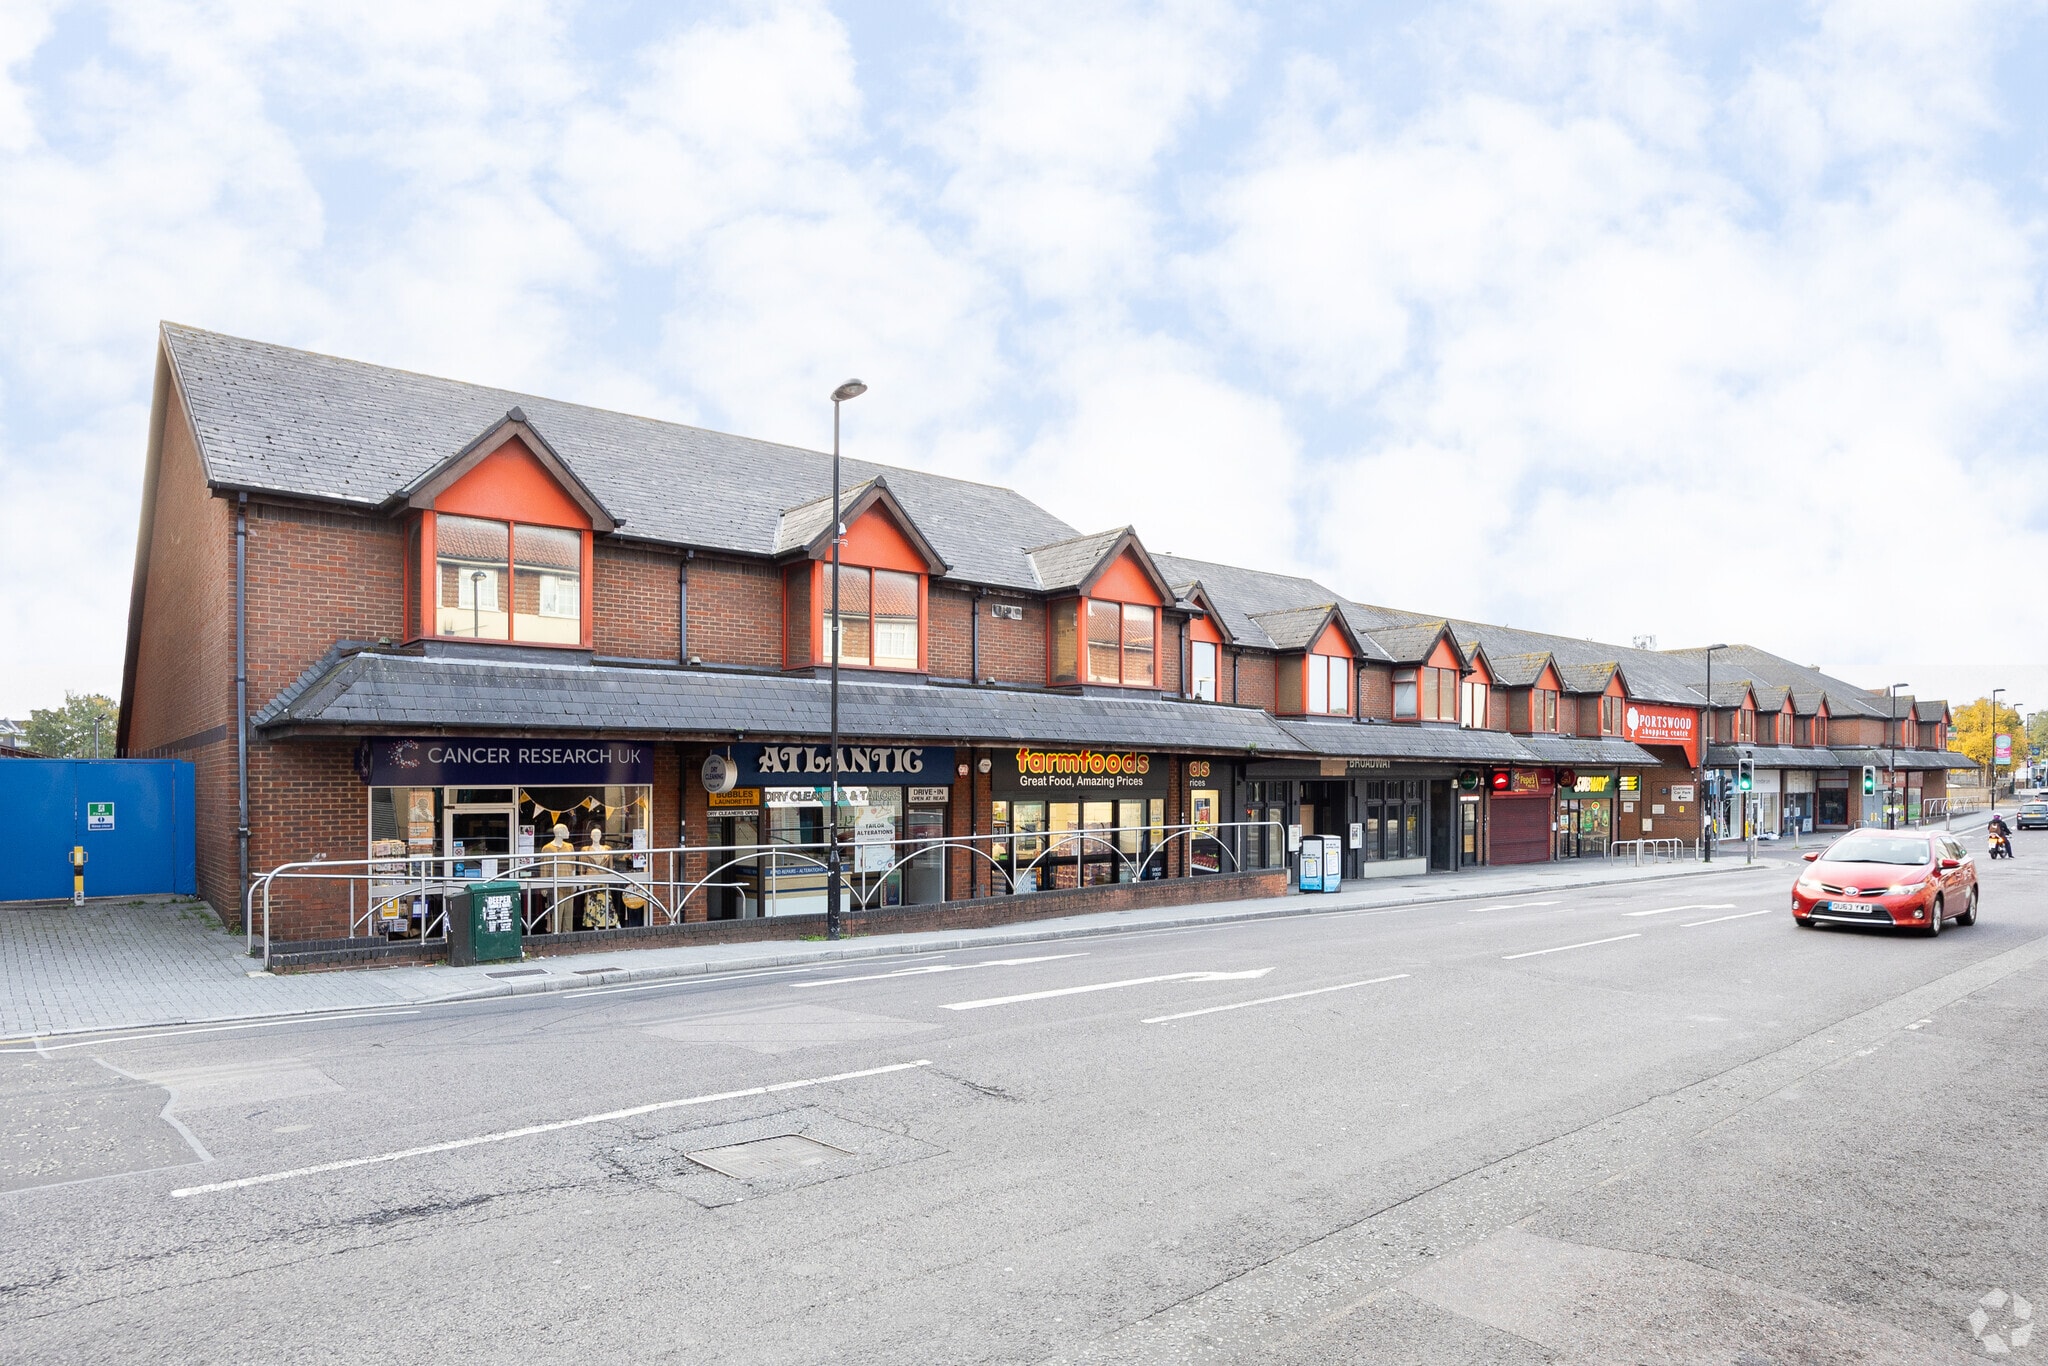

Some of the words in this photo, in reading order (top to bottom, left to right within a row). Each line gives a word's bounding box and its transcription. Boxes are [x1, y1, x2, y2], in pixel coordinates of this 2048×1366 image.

[1639, 714, 1692, 730] PORTSWOOD
[1642, 727, 1669, 737] shopping
[1670, 729, 1689, 737] centre
[427, 747, 511, 764] CANCER
[518, 748, 612, 764] RESEARCH
[617, 749, 641, 764] UK
[758, 746, 924, 773] ATLANTIC
[1016, 747, 1150, 774] farmfoods
[1019, 775, 1048, 787] Great
[1048, 775, 1075, 788] Food,
[1076, 775, 1115, 789] Amazing
[1116, 775, 1144, 787] Prices
[1573, 774, 1611, 793] SUBWAY
[765, 791, 788, 803] DRY
[789, 790, 847, 803] CLEANES
[849, 790, 859, 801] &
[860, 789, 902, 802] TAILORS
[856, 828, 894, 836] ALTERATIONS
